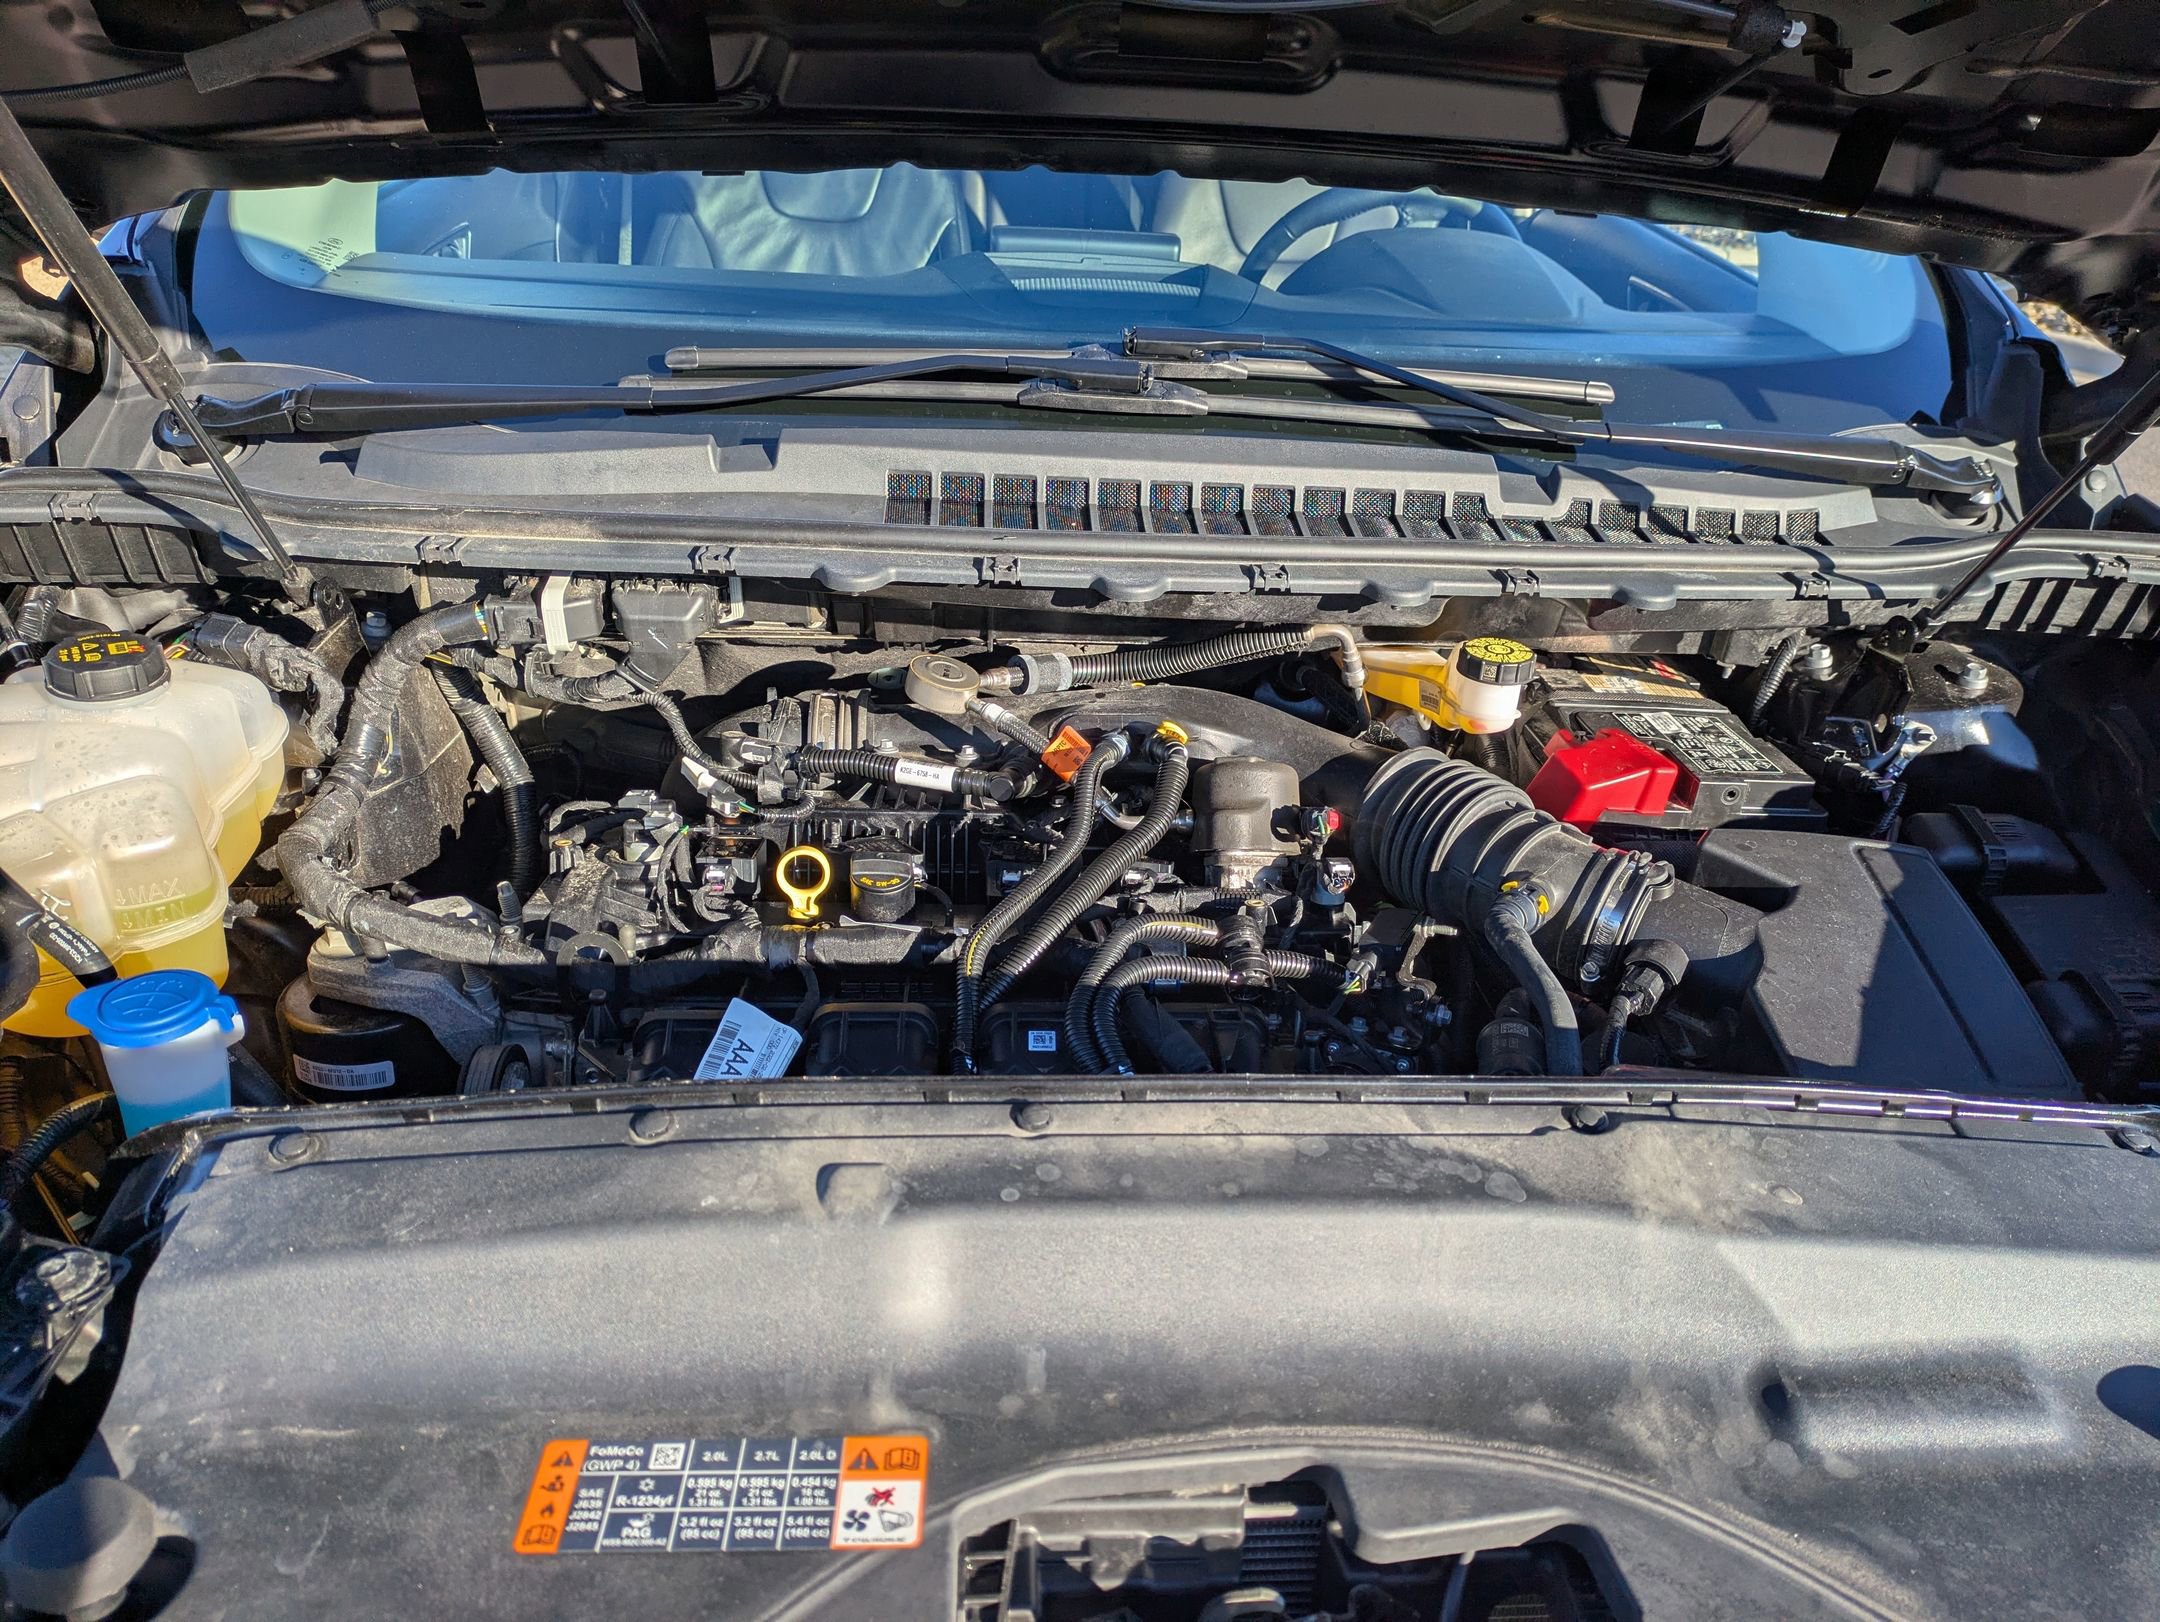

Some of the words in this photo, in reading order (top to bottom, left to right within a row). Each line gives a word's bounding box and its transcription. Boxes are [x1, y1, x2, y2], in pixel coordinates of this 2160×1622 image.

[860, 877, 874, 886] SAE
[127, 877, 182, 905] MAX
[134, 901, 187, 929] MIN
[720, 1038, 755, 1076] AAA
[589, 1445, 644, 1457] FoMoCo
[753, 1450, 780, 1462] 2.7L
[582, 1459, 624, 1474] (GWP
[625, 1460, 640, 1472] 4)
[718, 1478, 733, 1491] kg
[770, 1477, 786, 1490] kg
[822, 1475, 837, 1489] kg
[578, 1488, 605, 1498] SAE
[615, 1495, 674, 1508] R-1234yf
[621, 1527, 651, 1539] PAG
